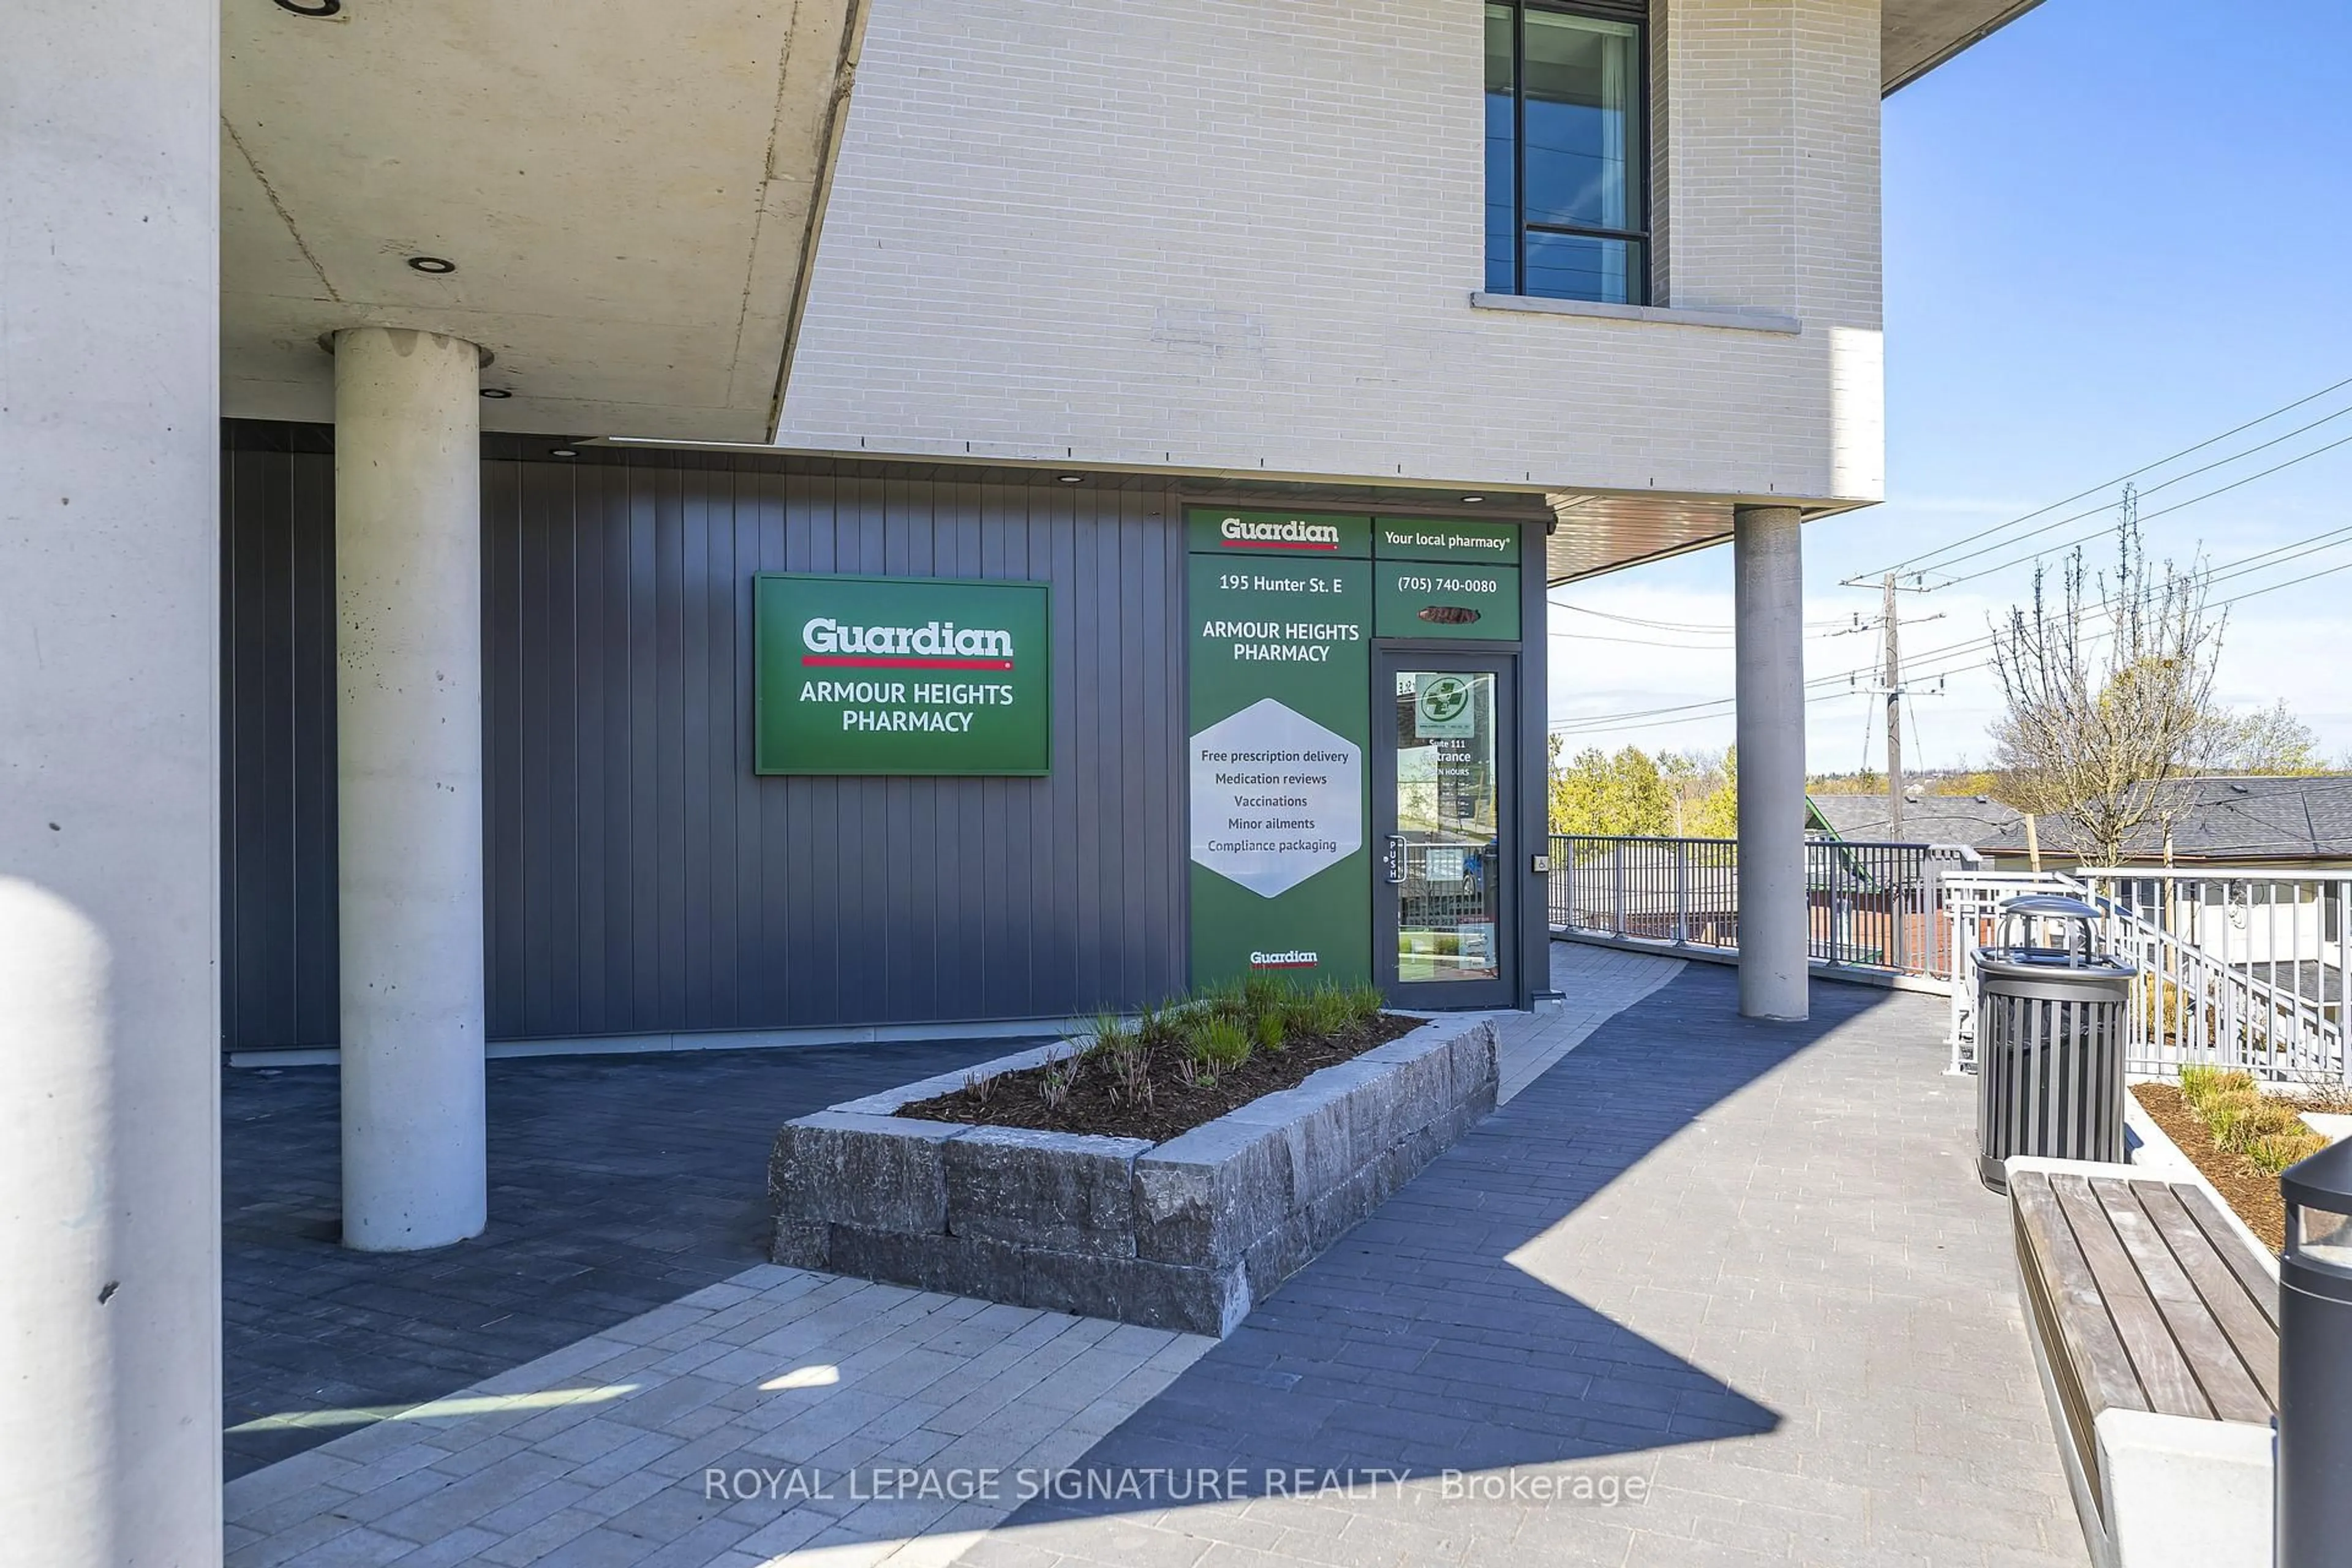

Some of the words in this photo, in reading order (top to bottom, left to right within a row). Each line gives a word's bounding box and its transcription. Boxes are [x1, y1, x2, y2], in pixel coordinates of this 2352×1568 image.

[1221, 518, 1339, 543] Guardian
[1385, 531, 1414, 546] Your
[1416, 532, 1446, 546] local
[1219, 575, 1249, 590] 195
[1254, 576, 1306, 592] Hunter
[1310, 578, 1329, 593] St.
[1333, 579, 1343, 593] E
[1398, 576, 1432, 592] (705)
[1435, 578, 1497, 593] 740-0080
[802, 617, 1014, 657] Guardian
[1202, 621, 1280, 639] ARMOUR
[1286, 624, 1359, 641] HEIGHTS
[1234, 644, 1330, 662] PHARMACY
[799, 681, 907, 703] ARMOUR
[913, 683, 1014, 706] HEIGHTS
[842, 710, 974, 733] PHARMACY
[1450, 739, 1466, 748] 111
[1201, 750, 1227, 761] Free
[1231, 750, 1300, 765] prescription
[1302, 750, 1349, 764] delivery
[1425, 750, 1471, 762] trance
[1215, 773, 1280, 785] Medication
[1283, 774, 1327, 785] reviews
[1234, 796, 1308, 807] Vaccinations
[1228, 818, 1262, 829] Minor
[1265, 818, 1315, 830] ailments
[1208, 840, 1276, 852] Compliance
[1279, 840, 1336, 853] packaging
[1250, 950, 1318, 964] Guardian
